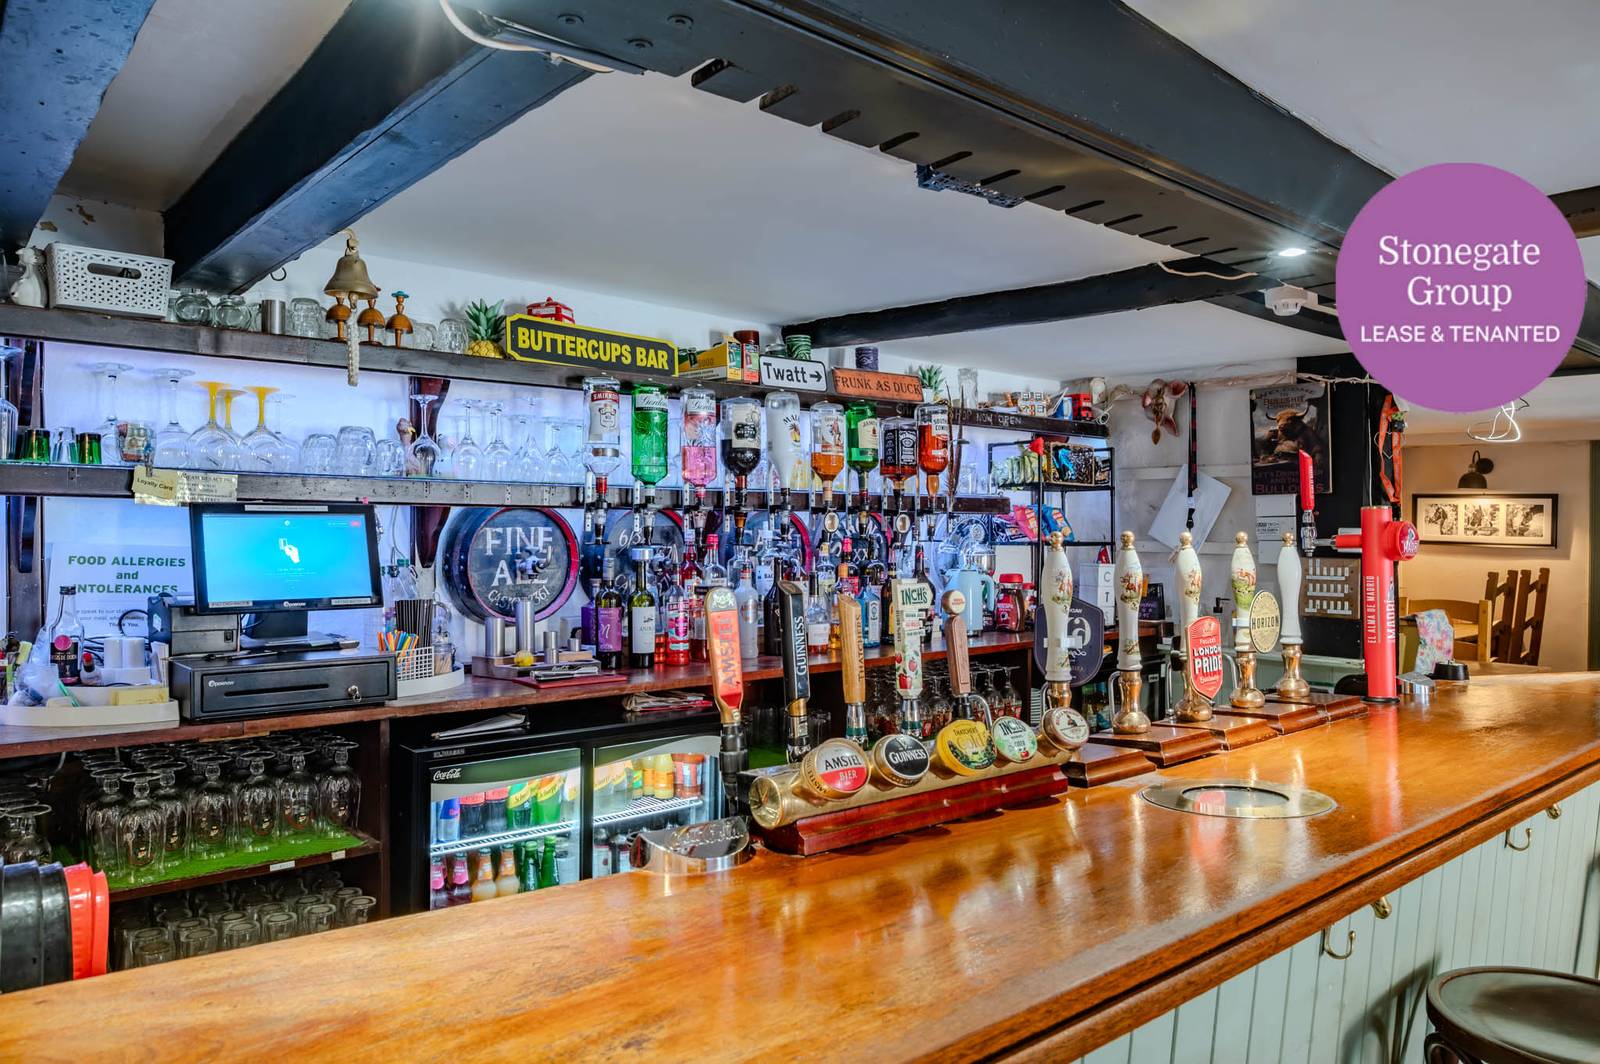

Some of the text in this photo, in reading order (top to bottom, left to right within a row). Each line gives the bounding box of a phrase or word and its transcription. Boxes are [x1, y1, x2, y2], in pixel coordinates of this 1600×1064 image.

[517, 326, 669, 370] BUTTERCUPS BAR
[763, 362, 808, 383] Twatt
[835, 375, 921, 395] FRUNK AS DUCK
[592, 392, 619, 400] SMIRNO
[137, 477, 173, 491] Loyalty Card
[1255, 483, 1324, 495] BULLOS
[484, 527, 553, 556] FINE
[68, 555, 186, 568] FOOD ALLERGIES
[116, 571, 139, 580] and
[491, 559, 549, 588] AL
[74, 584, 178, 594] NTOLERANCES
[1365, 575, 1377, 644] EL ALMA DE MADRID
[1251, 614, 1280, 630] HORIZON
[718, 616, 738, 689] AMSTEL
[794, 615, 807, 676] GUINNESS
[1193, 645, 1222, 657] LONDON
[1194, 655, 1223, 675] PRIDE
[824, 755, 862, 771] AMSTEL
[889, 748, 927, 765] GUINNESS
[839, 769, 858, 782] BIER
